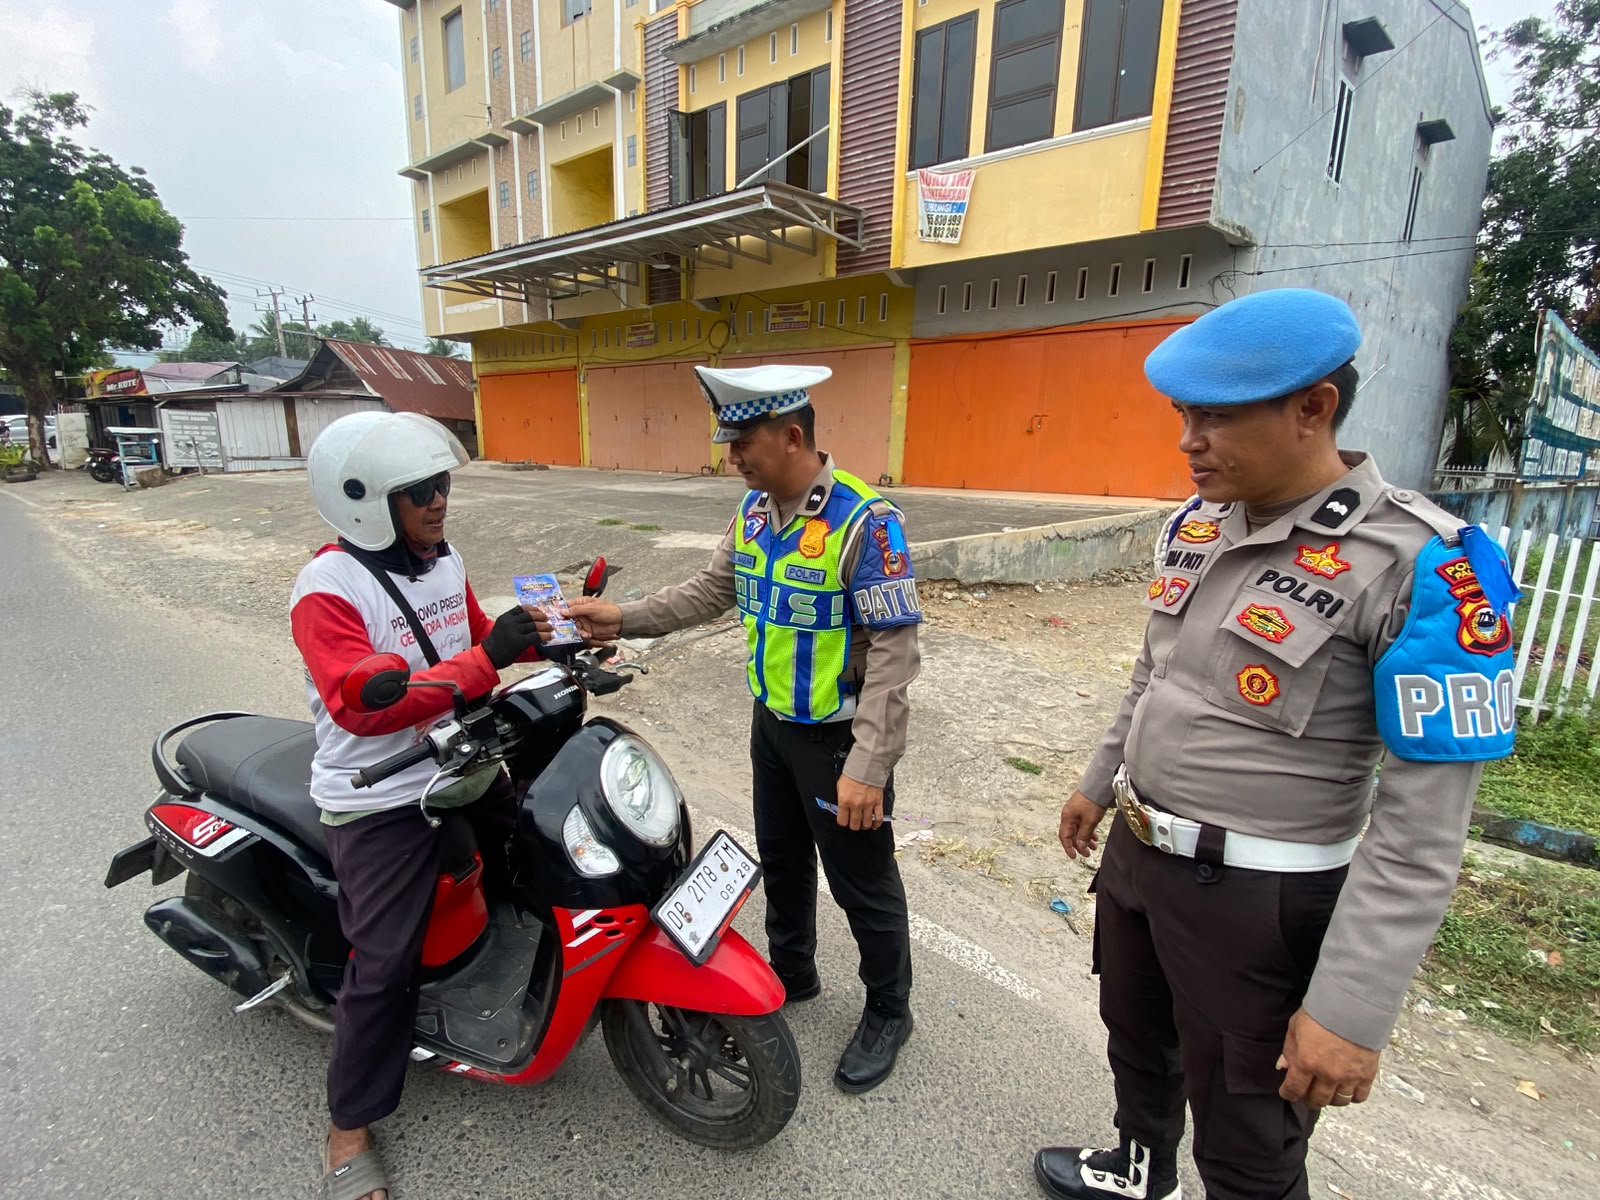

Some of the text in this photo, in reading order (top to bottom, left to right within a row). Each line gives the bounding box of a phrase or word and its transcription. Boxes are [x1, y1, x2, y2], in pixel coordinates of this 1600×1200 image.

[788, 567, 821, 581] POLRI
[1179, 551, 1206, 571] PATI
[1255, 568, 1345, 620] POLRI
[553, 684, 579, 700] HONDA
[1394, 668, 1515, 738] PRO
[667, 841, 738, 931] DP 2178 TM
